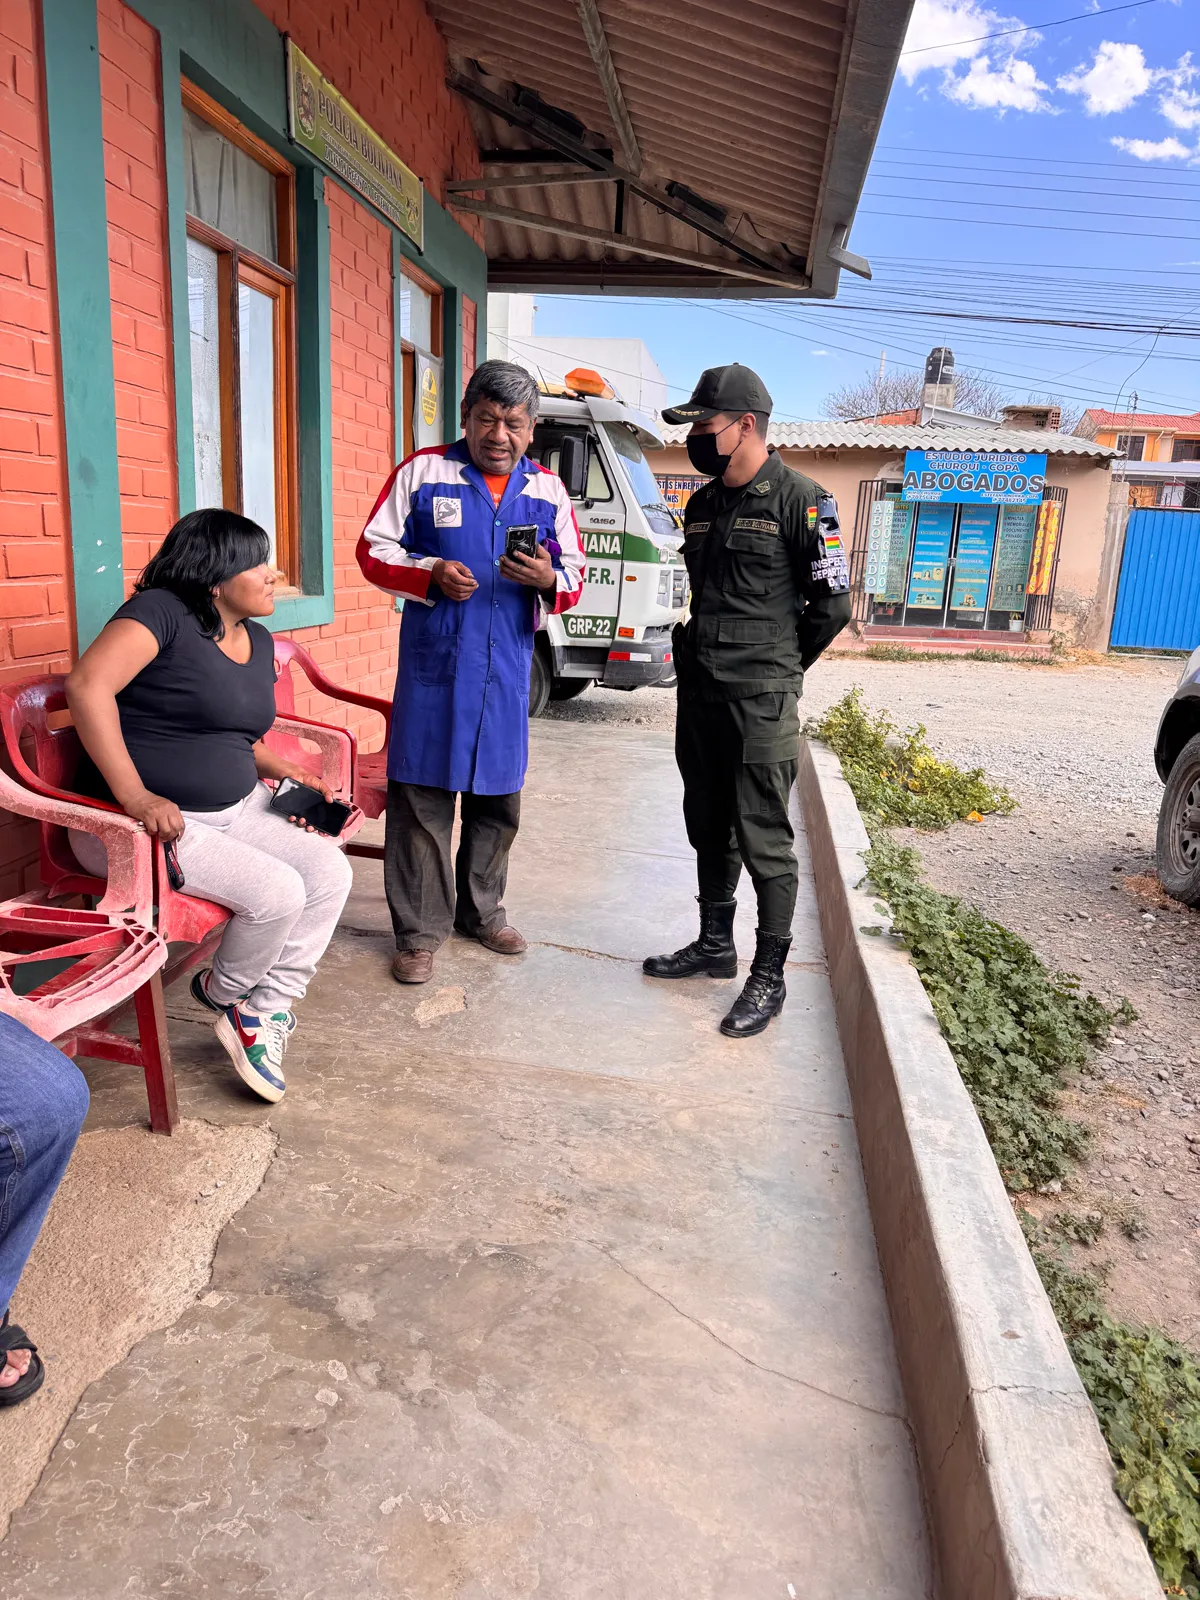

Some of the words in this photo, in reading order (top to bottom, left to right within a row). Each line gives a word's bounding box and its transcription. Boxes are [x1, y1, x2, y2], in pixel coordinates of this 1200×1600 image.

[318, 88, 359, 152] POLICIA
[361, 132, 403, 197] BOLIVIANA
[925, 452, 972, 461] ESTUDIO
[975, 454, 1026, 462] JURIDICO
[930, 462, 979, 471] CHURQUI
[989, 464, 1020, 472] COPA
[903, 471, 1044, 494] ABOGADOS
[866, 503, 883, 588] ABOGADO
[879, 503, 892, 588] ABOGADO
[584, 567, 615, 585] .F.R.
[568, 617, 611, 636] GRP-22
